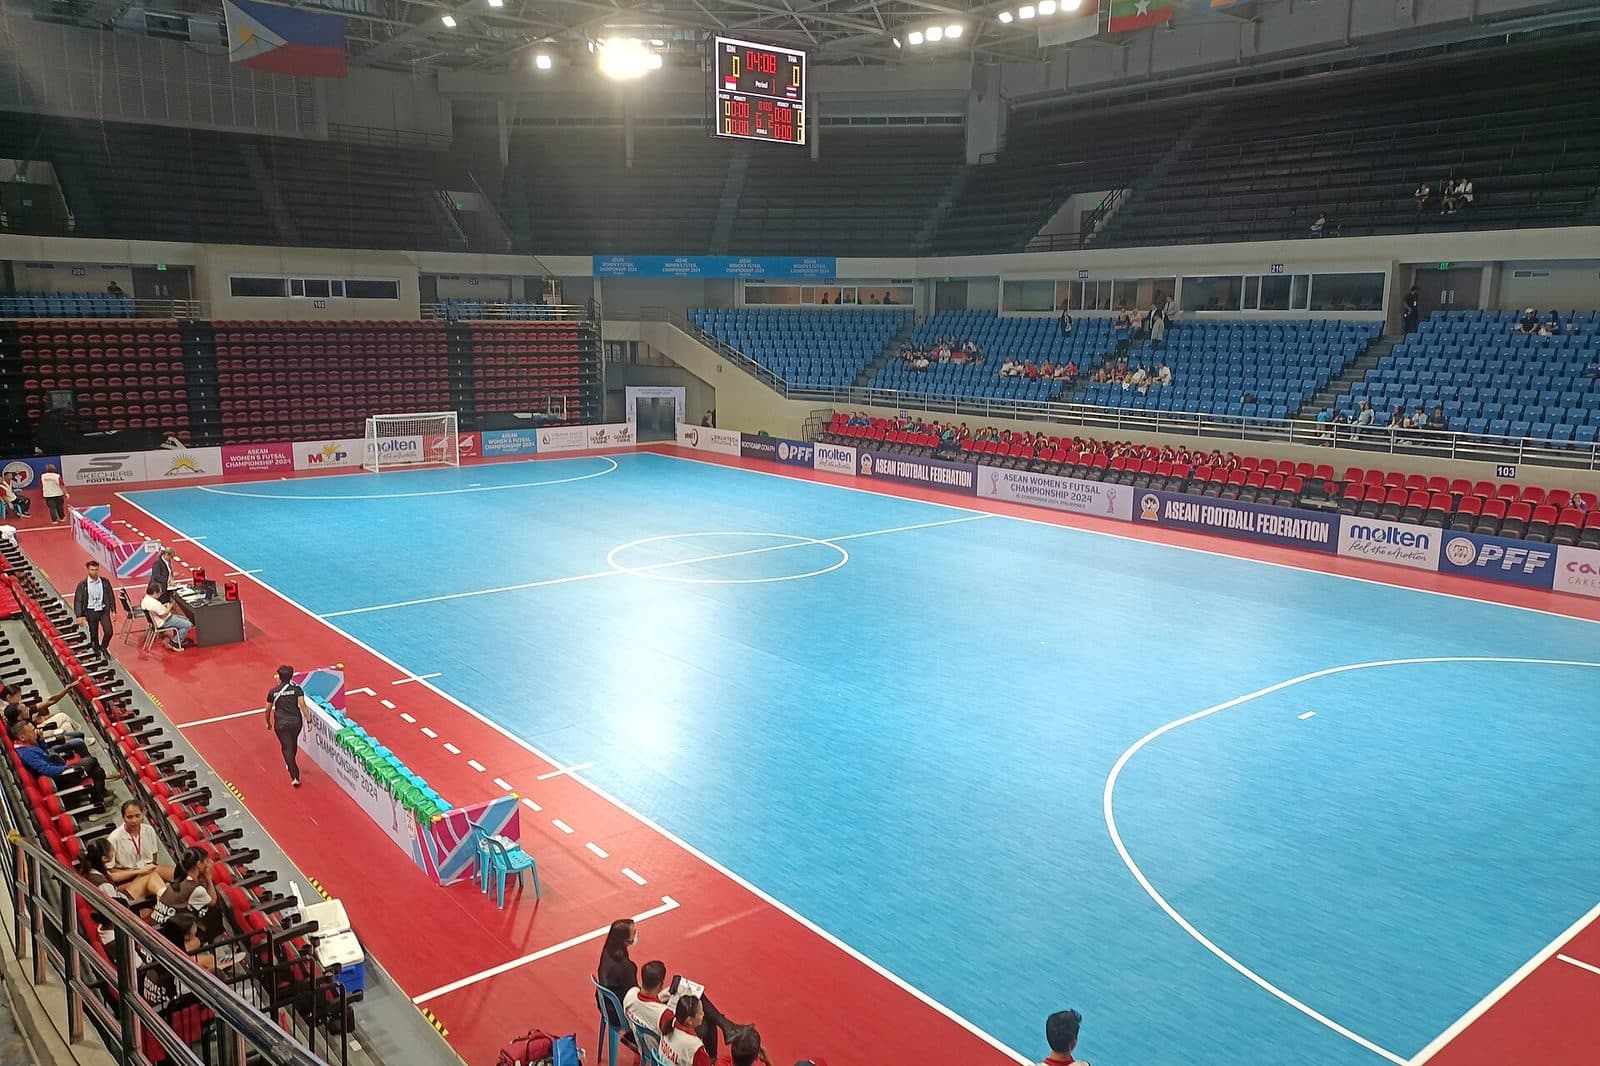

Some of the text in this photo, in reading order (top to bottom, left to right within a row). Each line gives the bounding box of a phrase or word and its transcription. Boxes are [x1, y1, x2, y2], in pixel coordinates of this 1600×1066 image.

[1272, 265, 1283, 274] 210
[790, 446, 813, 461] PFF
[818, 448, 852, 463] molten
[226, 460, 273, 468] CHAMPIONSHIP
[875, 458, 972, 488] ASEAN FOOTBALL FEDERATION
[1498, 466, 1515, 477] 103
[76, 470, 134, 480] SKECHERS
[1004, 473, 1102, 494] ASEAN WOMEN'S FUTSAL
[1010, 484, 1092, 504] CHAMPIONSHIP 2024
[1165, 500, 1330, 544] ASEAN FOOTBALL FEDERATION
[1350, 524, 1430, 550] molten
[1476, 544, 1551, 574] PFF
[316, 733, 360, 782] CHAMPIONSHIP
[361, 775, 379, 802] 2024
